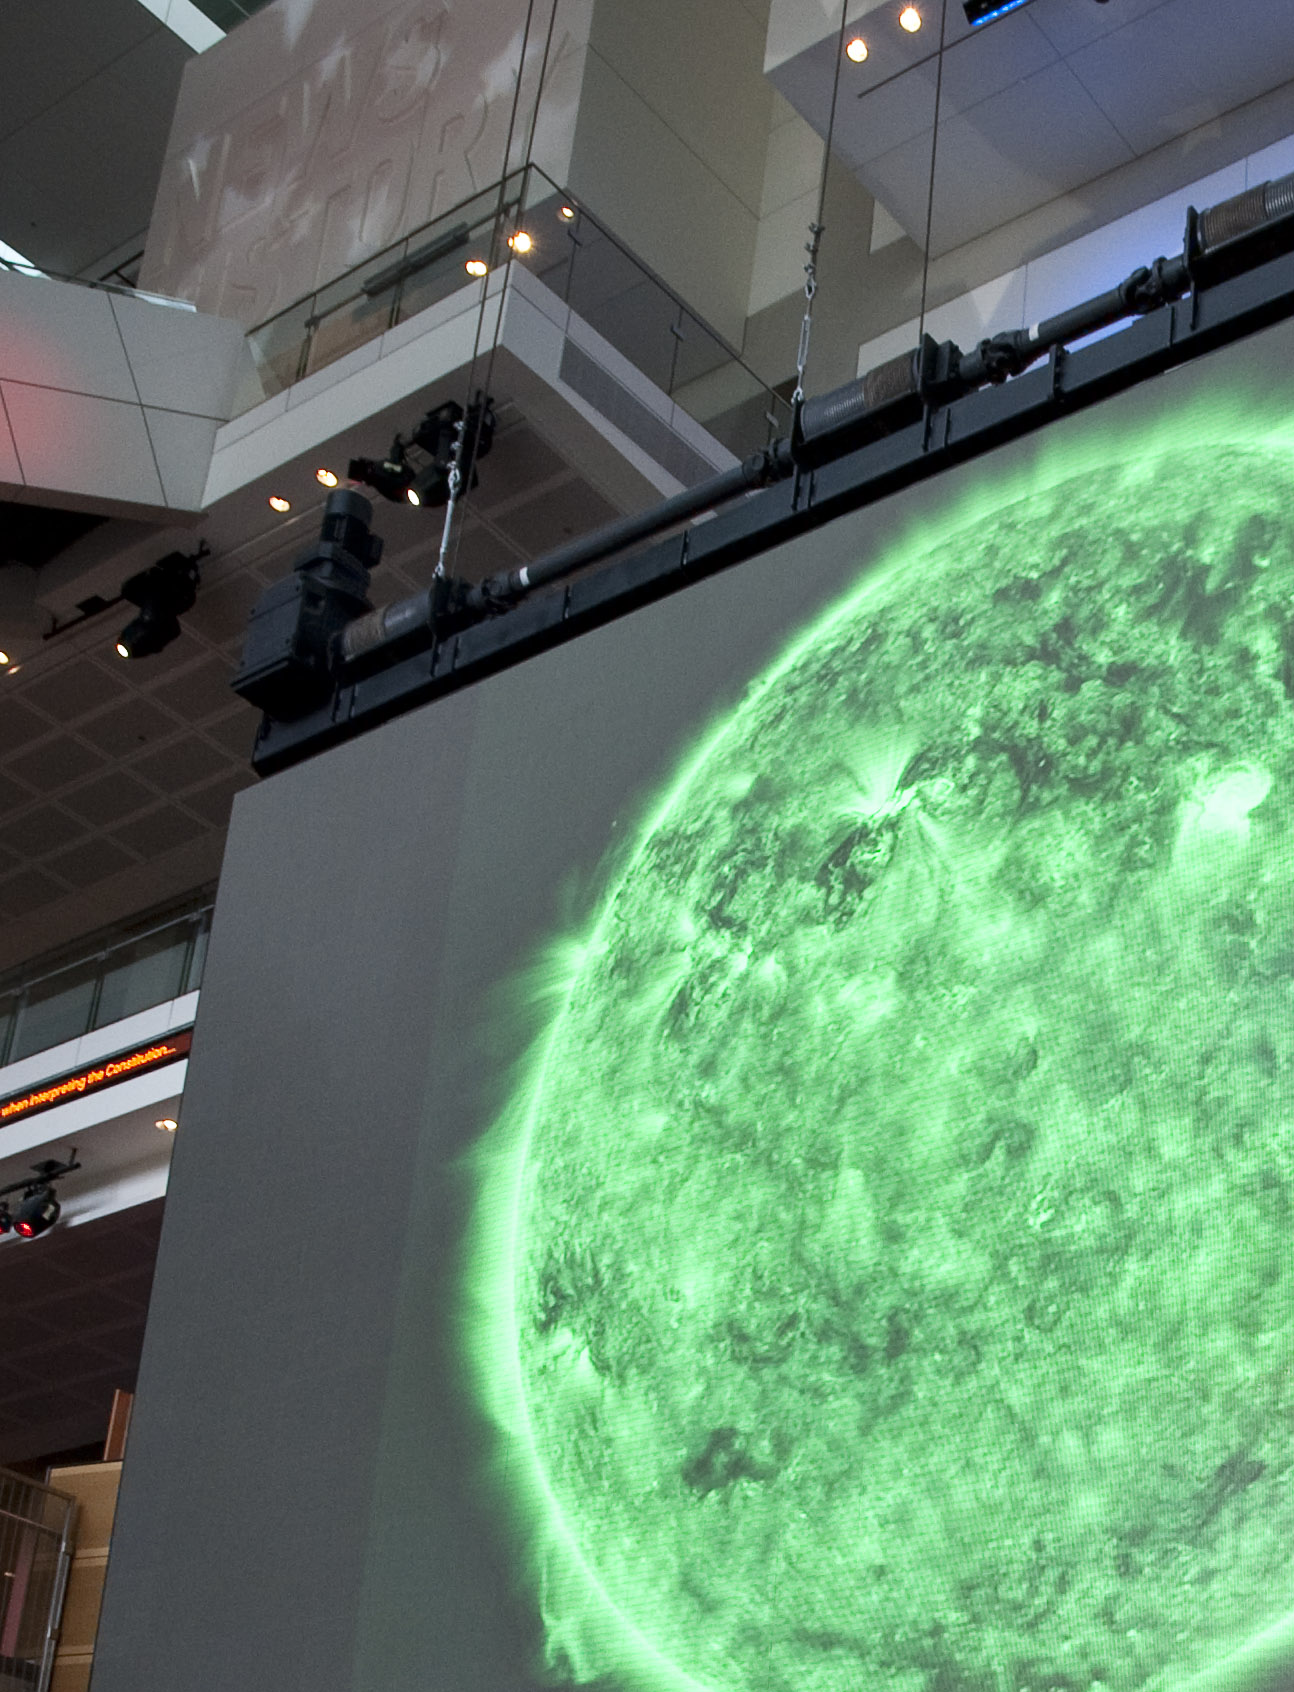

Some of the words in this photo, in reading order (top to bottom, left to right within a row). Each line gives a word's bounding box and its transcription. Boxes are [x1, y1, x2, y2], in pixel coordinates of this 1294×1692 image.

[1, 1099, 29, 1117] when
[29, 1076, 87, 1106] interpreting
[87, 1069, 105, 1084] the
